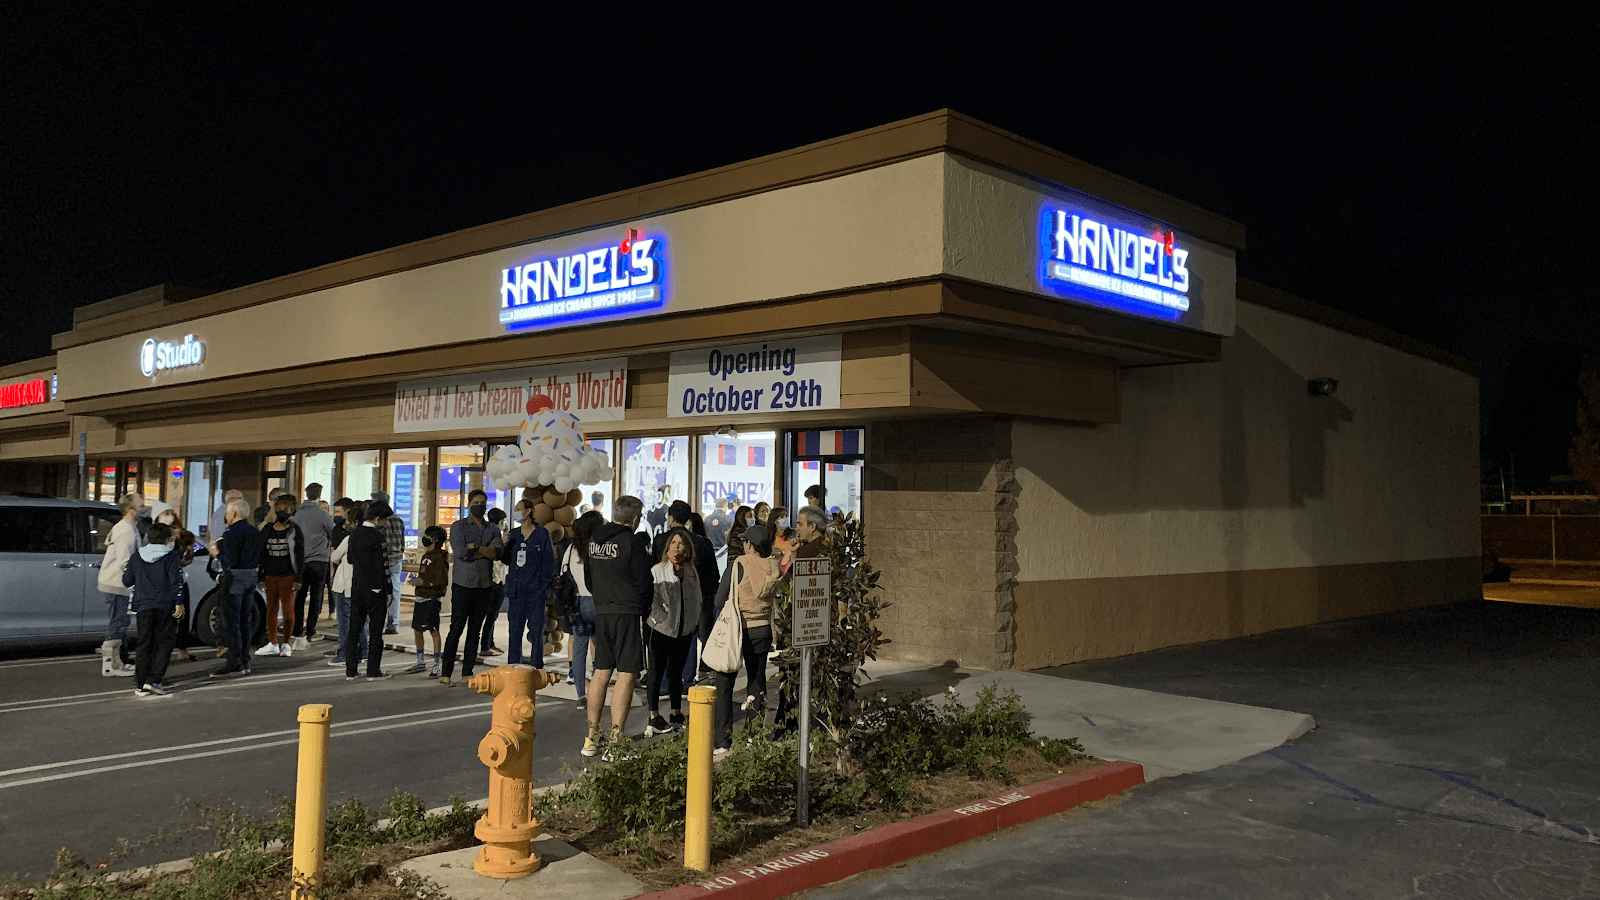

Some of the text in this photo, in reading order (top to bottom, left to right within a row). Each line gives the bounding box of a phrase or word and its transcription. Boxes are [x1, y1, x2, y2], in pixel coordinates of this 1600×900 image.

[500, 228, 656, 308] HANDEL'S
[1056, 210, 1189, 293] HANDEL'S
[156, 334, 202, 369] Studio
[708, 344, 796, 381] Opening
[397, 390, 430, 422] Voted
[433, 386, 450, 419] #1
[453, 384, 474, 418] Ice
[478, 381, 522, 417] Cream
[547, 375, 571, 411] the
[576, 368, 625, 410] World
[682, 379, 822, 414] October 29th
[796, 560, 830, 575] FIRE LANE
[808, 578, 817, 588] NO
[797, 598, 828, 609] TOW AWAY
[801, 587, 825, 598] PARKING
[805, 609, 819, 619] ZONE
[954, 803, 997, 816] FIRE
[701, 849, 830, 890] NO PARKING
